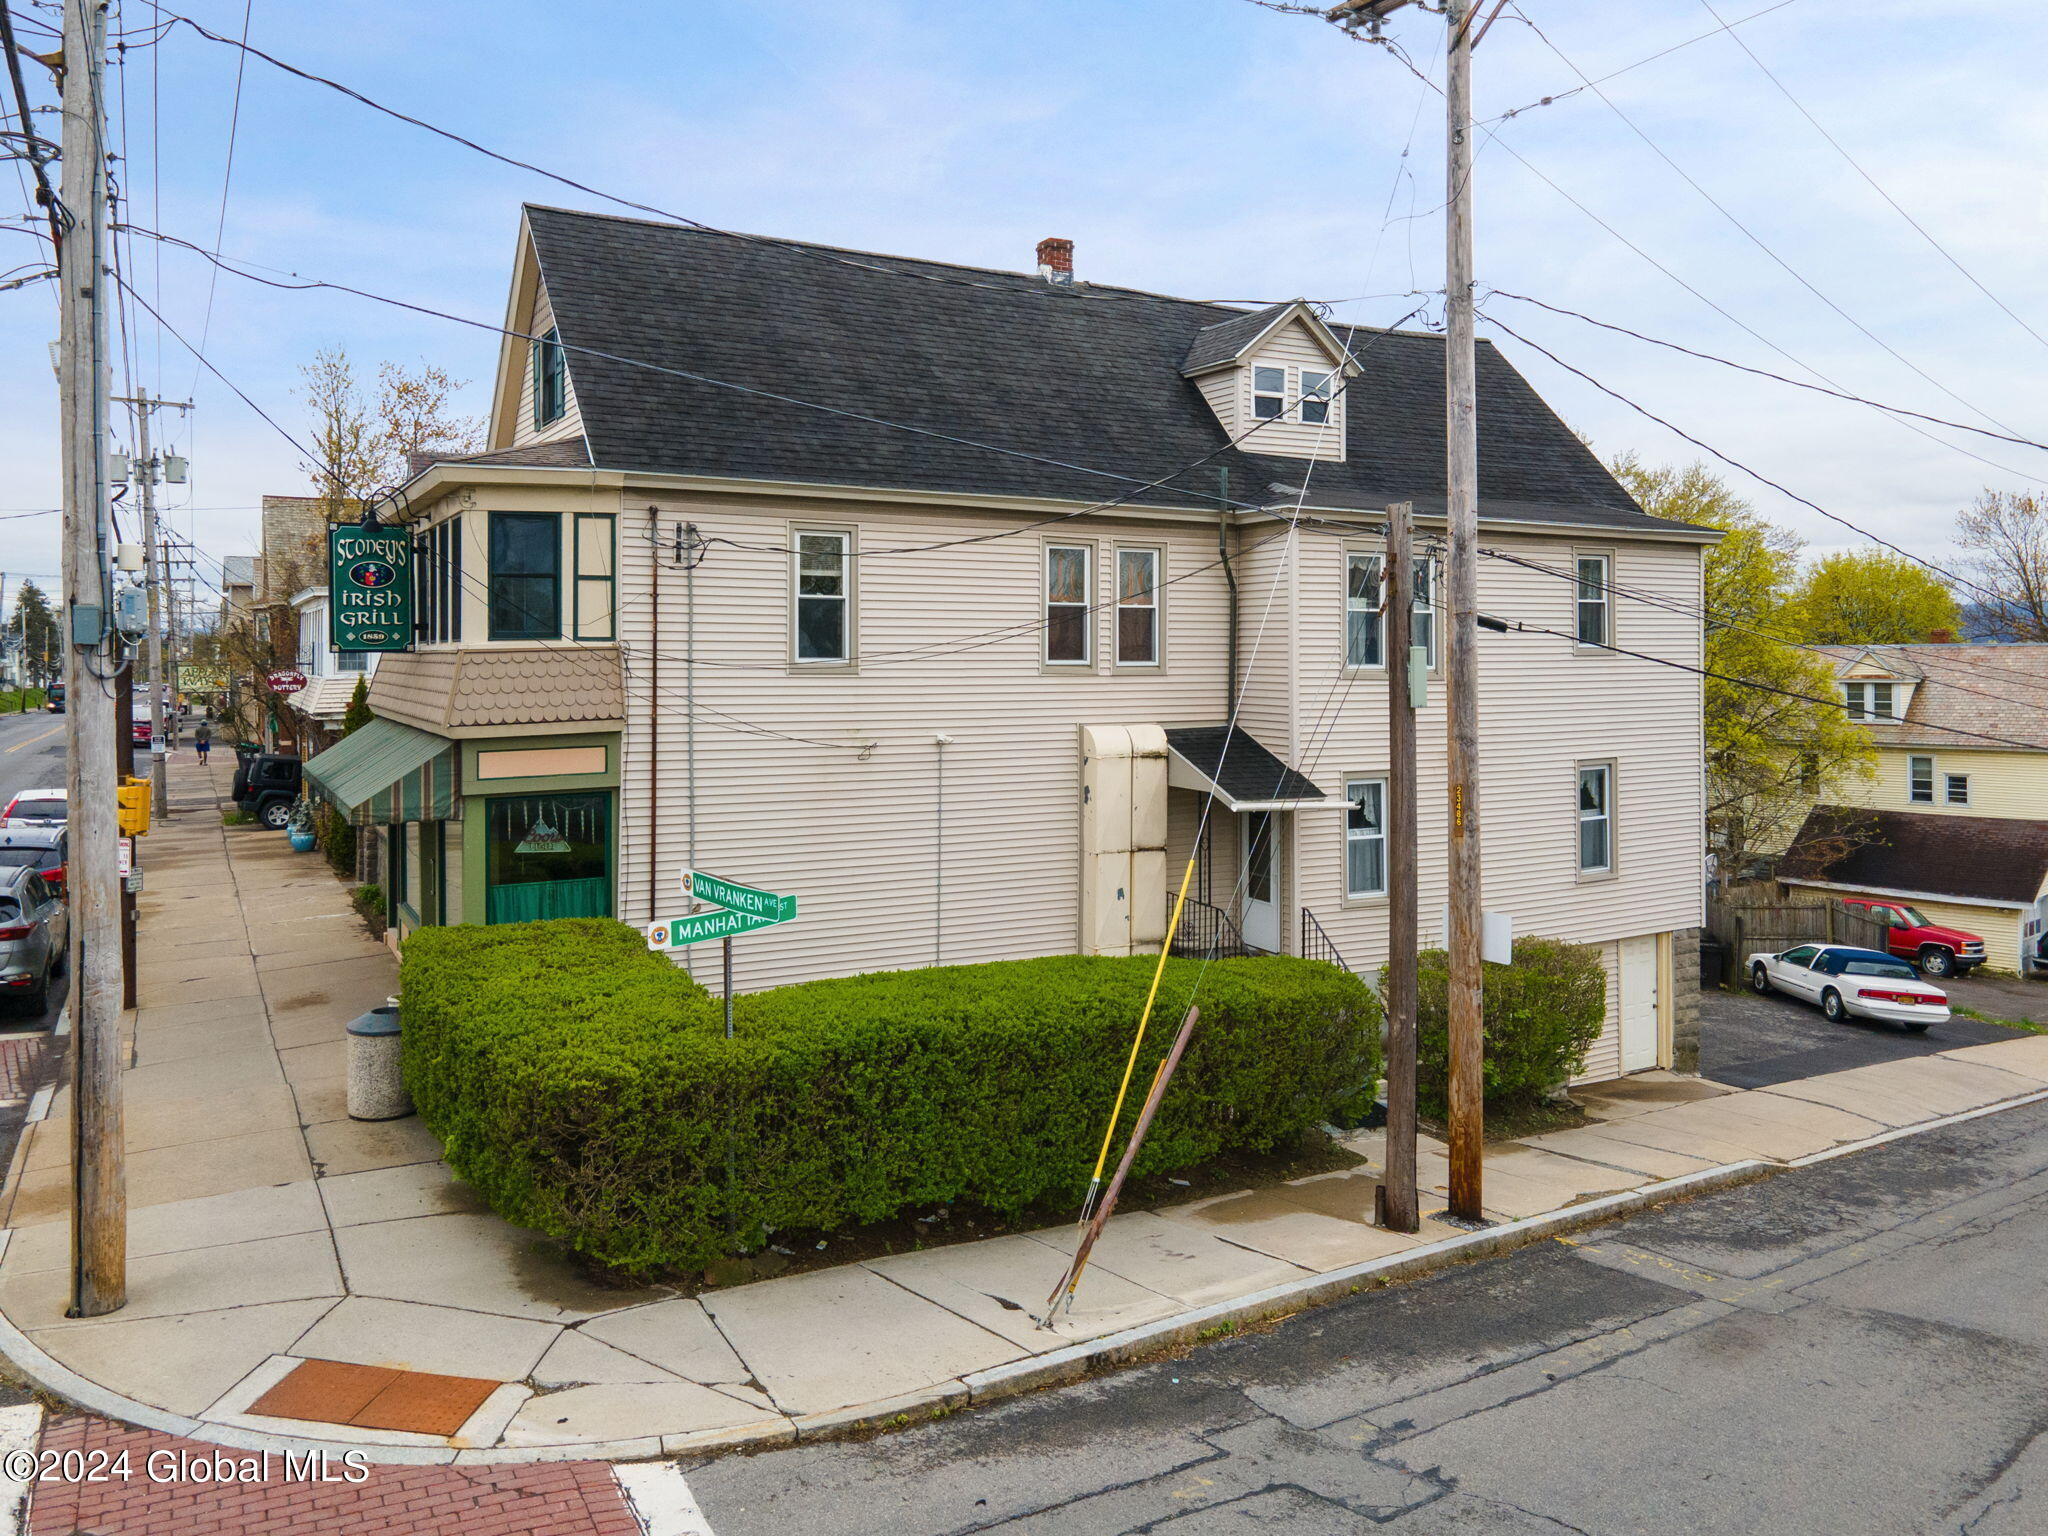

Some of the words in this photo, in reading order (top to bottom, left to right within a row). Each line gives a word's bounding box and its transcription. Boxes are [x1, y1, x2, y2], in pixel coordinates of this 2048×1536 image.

[340, 609, 404, 627] GRILL
[269, 670, 305, 682] DRAGONFLY
[273, 684, 302, 692] POTTERY
[694, 878, 712, 898] VAN
[713, 882, 763, 913] VRANKEN
[763, 897, 777, 909] AVE
[679, 913, 766, 940] MANHATTA
[779, 901, 788, 912] ST
